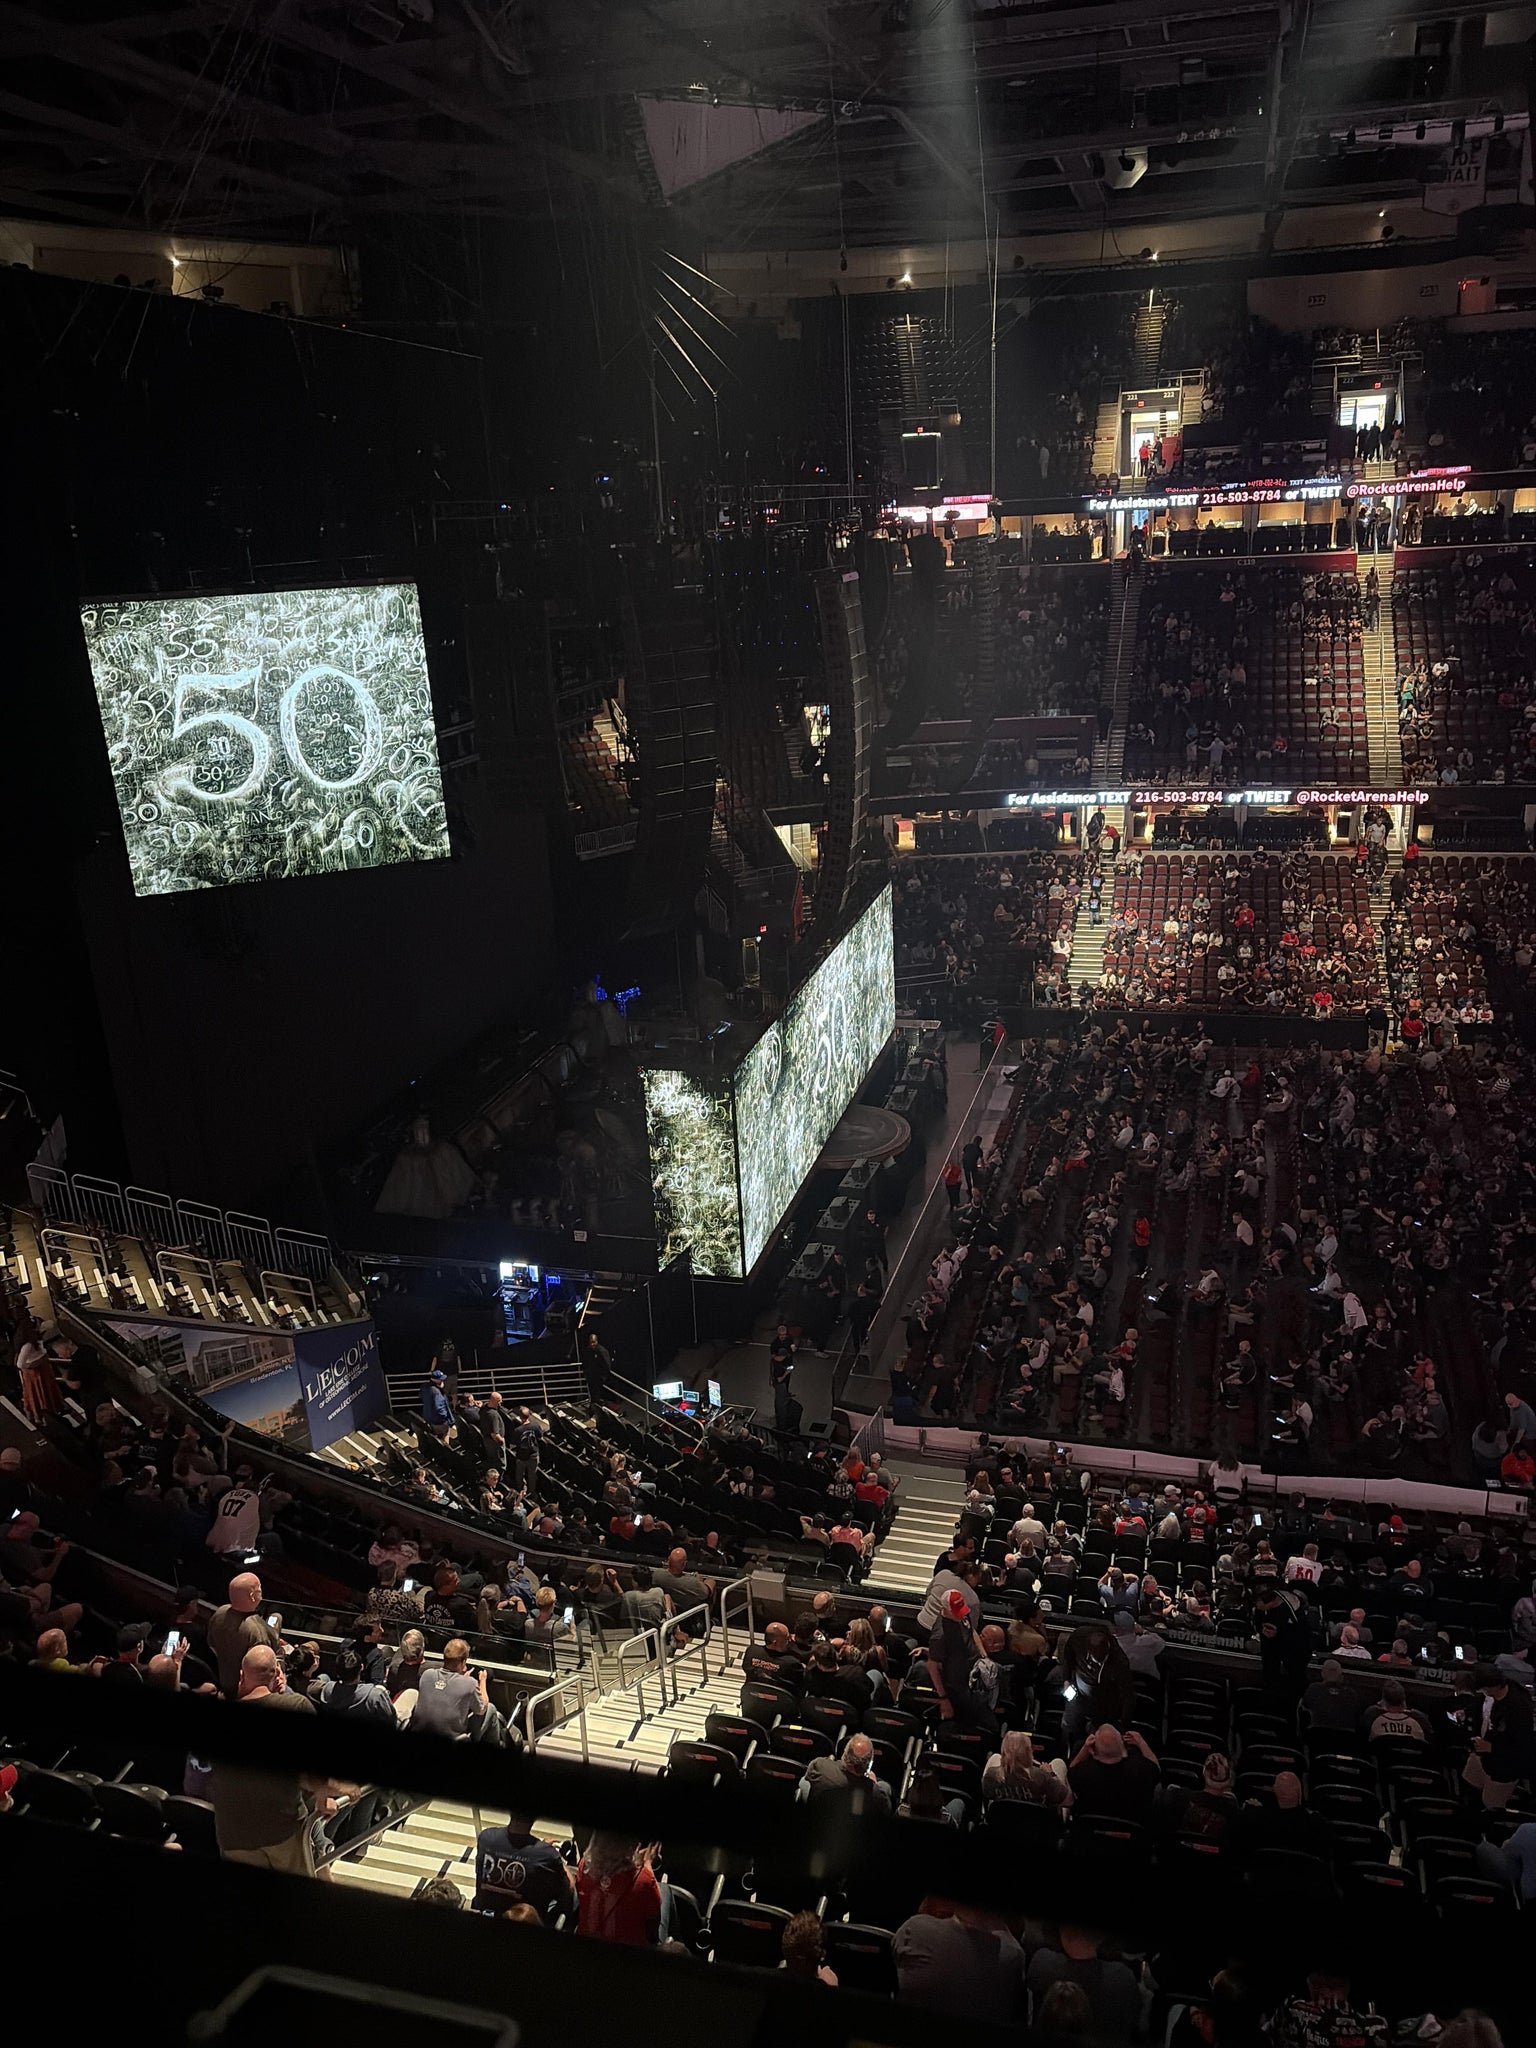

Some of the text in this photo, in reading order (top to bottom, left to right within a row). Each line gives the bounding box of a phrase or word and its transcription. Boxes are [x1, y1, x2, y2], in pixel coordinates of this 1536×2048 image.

[1090, 498, 1108, 511] For
[1109, 495, 1169, 509] Assistance
[1170, 493, 1200, 507] TEXT
[1202, 490, 1282, 505] 216-503-8784
[1285, 490, 1300, 501] or
[1301, 485, 1343, 500] TWEET
[1346, 477, 1467, 499] @RocketArenaHelp
[158, 657, 383, 801] 50
[1008, 790, 1430, 806] For Assistance TEXT 216-503-8784 or TWEET @RocketArenaHelp
[222, 1498, 247, 1518] 07
[1381, 1721, 1412, 1735] TOUR
